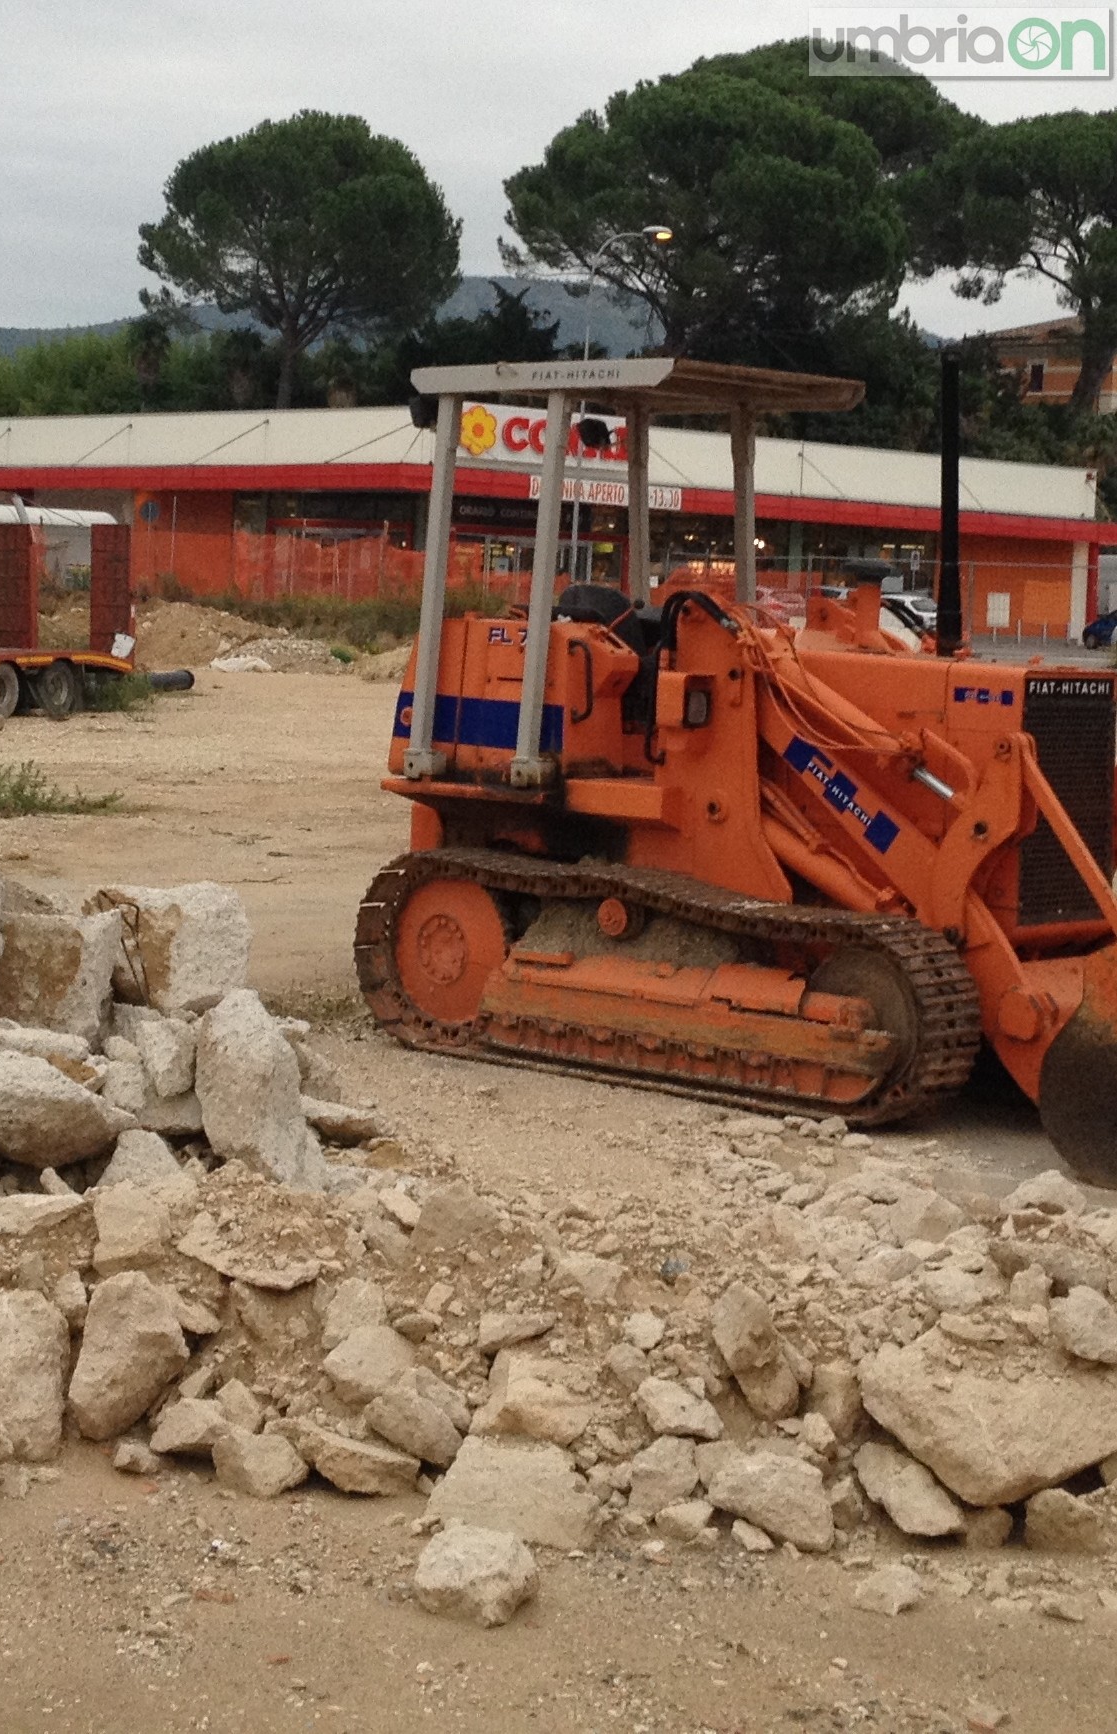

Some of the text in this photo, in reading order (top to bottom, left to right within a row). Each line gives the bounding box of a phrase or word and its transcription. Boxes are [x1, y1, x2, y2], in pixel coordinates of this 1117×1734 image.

[531, 369, 620, 381] FIAT-HITACHI
[588, 483, 625, 503] APERTO
[488, 627, 513, 645] FL
[1029, 681, 1110, 695] FIAT-HITACHI
[806, 761, 872, 826] FIAT-HITACHI
